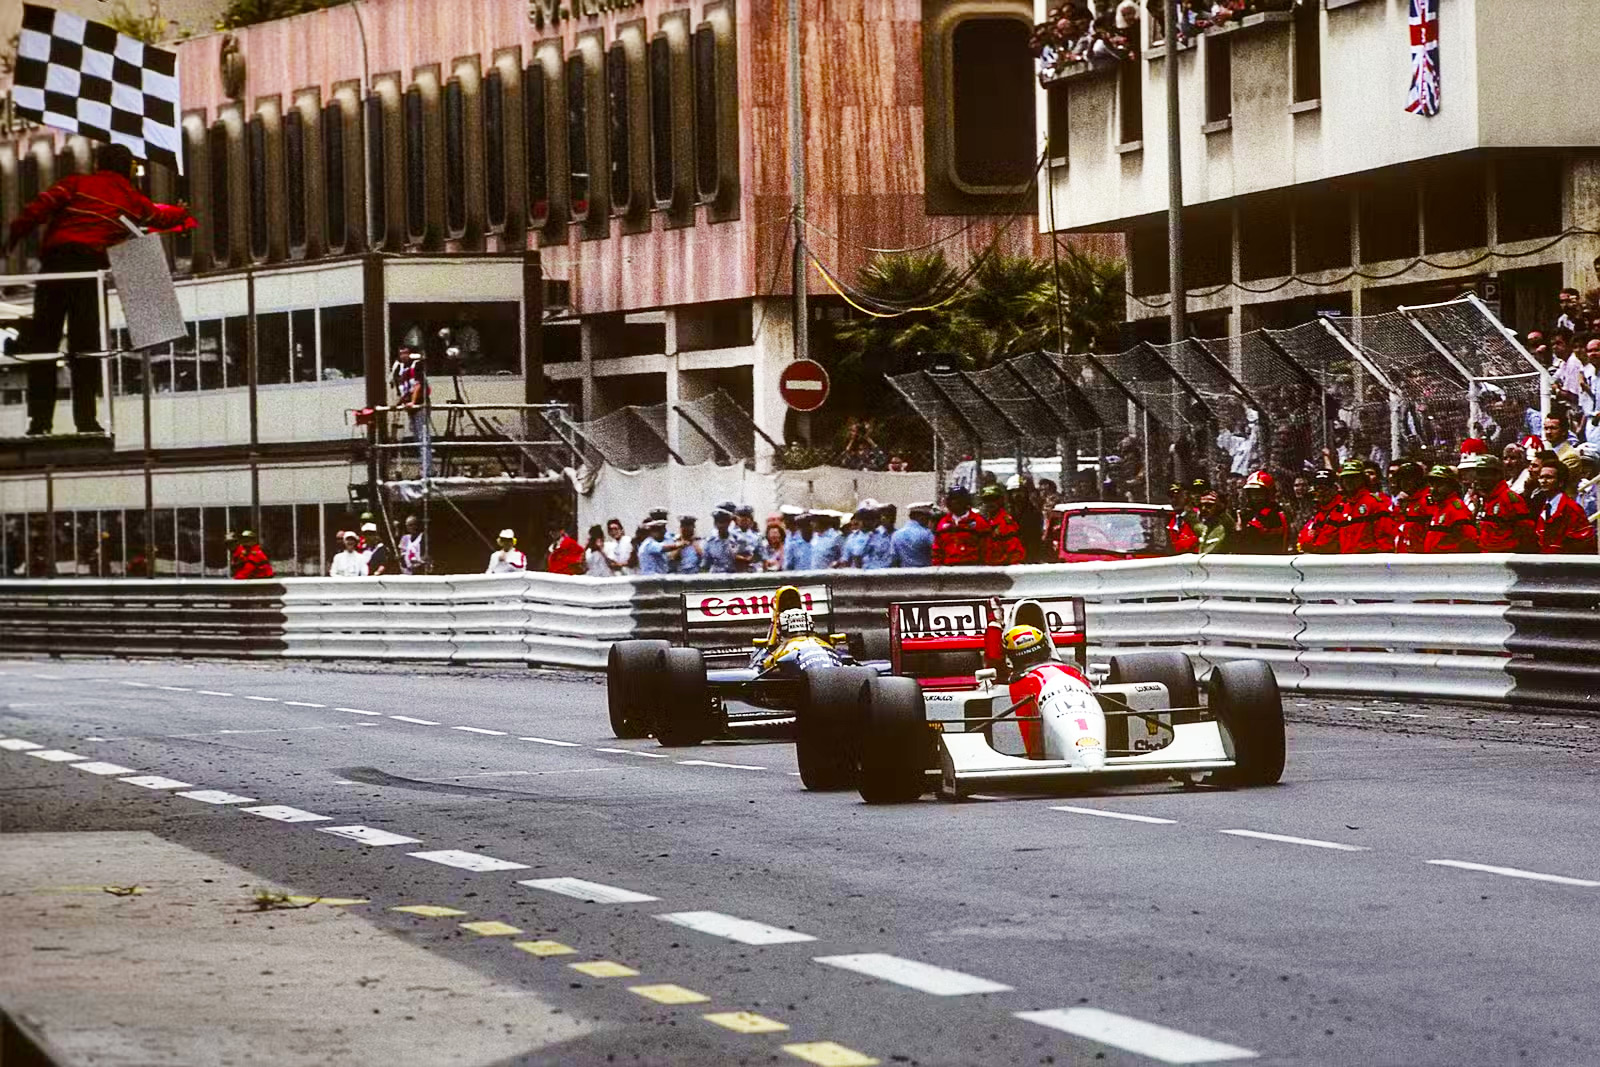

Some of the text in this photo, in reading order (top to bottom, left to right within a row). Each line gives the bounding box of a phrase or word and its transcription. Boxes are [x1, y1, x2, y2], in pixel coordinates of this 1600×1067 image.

[1484, 284, 1497, 300] P
[700, 592, 813, 617] Cann
[900, 605, 1064, 639] Marlo
[1074, 718, 1089, 731] 1
[1134, 737, 1170, 751] Shel
